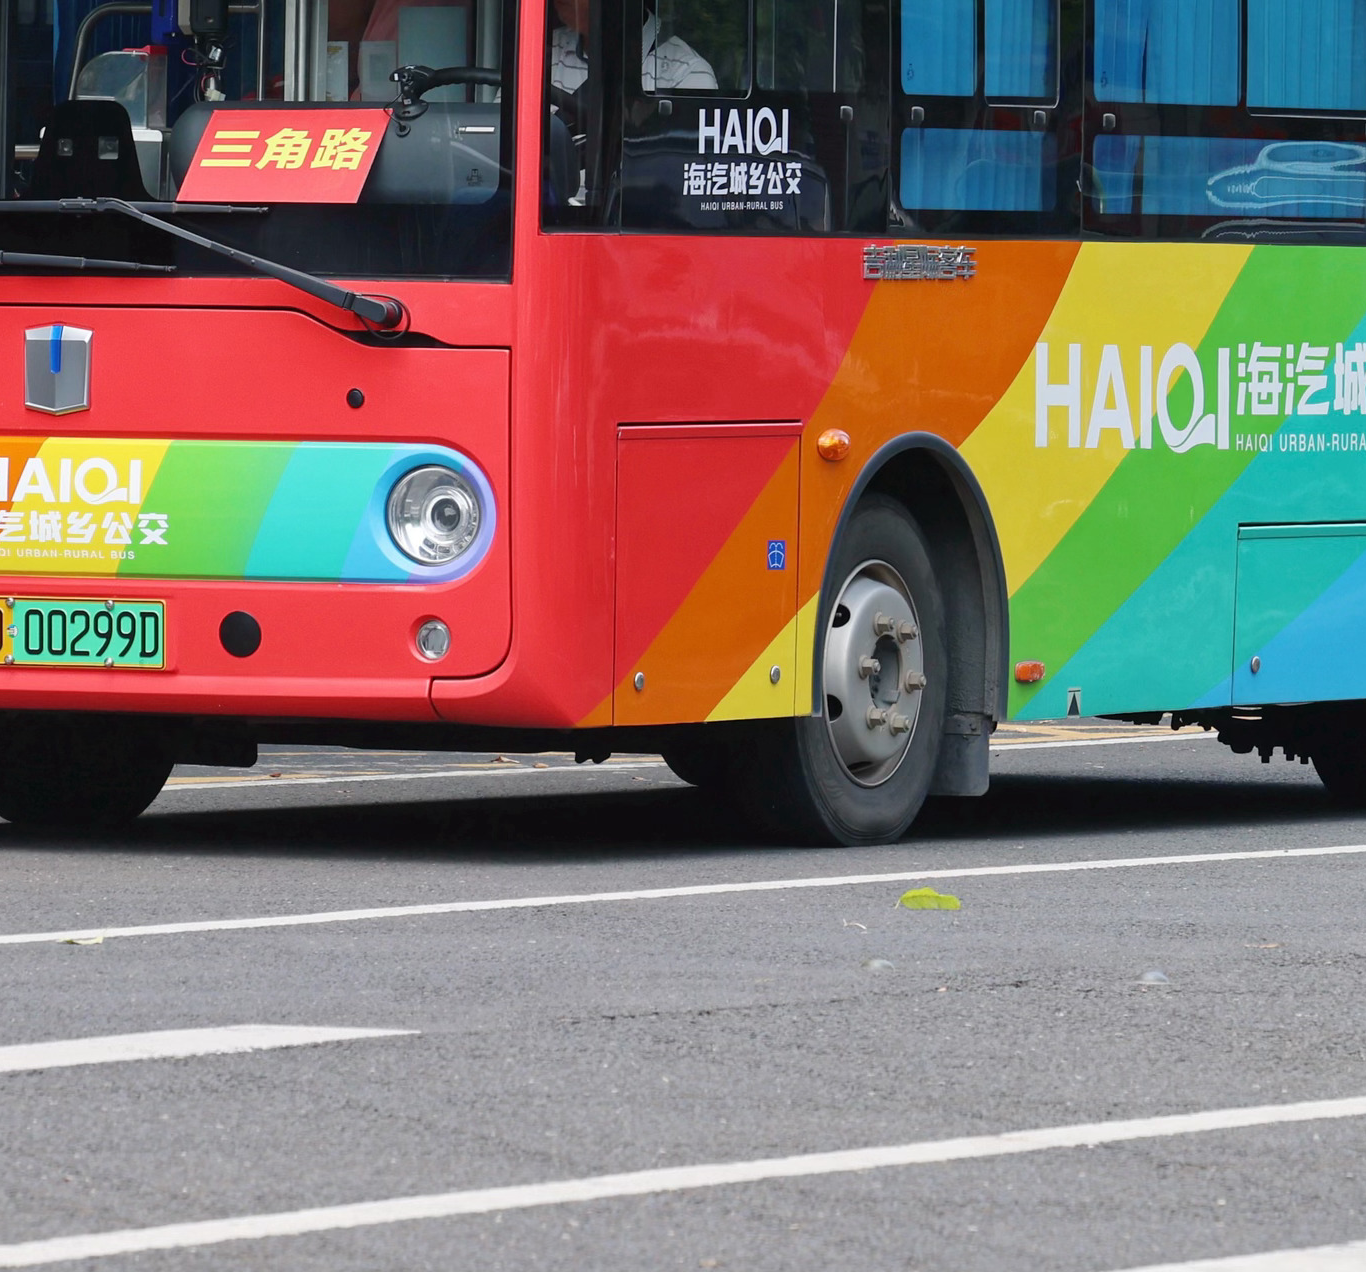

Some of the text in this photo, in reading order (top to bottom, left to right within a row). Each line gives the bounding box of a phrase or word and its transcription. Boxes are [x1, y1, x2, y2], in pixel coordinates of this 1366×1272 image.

[199, 127, 372, 171] 三角路
[698, 107, 789, 156] HAIQI
[683, 162, 802, 195] 海汽城乡公交
[700, 201, 784, 210] HAIQI URBAN-RURAL BUS
[1035, 342, 1231, 453] HAIQI
[1236, 432, 1274, 452] HAIQI
[16, 548, 105, 559] URBAN-RURAL
[110, 550, 136, 560] BUS
[24, 608, 160, 659] 00299D
